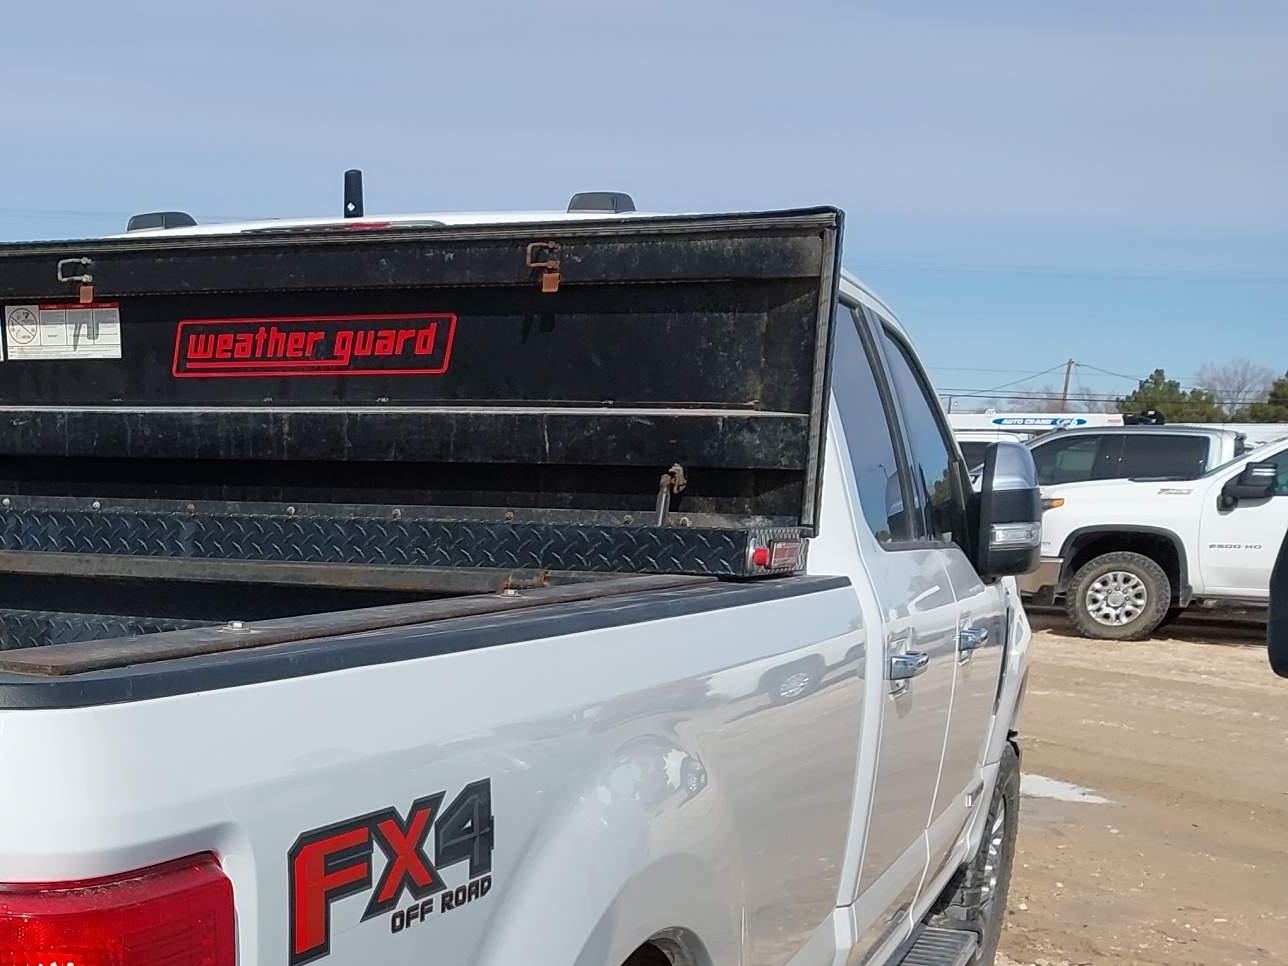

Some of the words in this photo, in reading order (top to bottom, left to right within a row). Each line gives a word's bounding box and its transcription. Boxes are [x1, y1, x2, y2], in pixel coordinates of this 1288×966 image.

[187, 325, 326, 360] weather
[335, 322, 438, 366] guard
[390, 898, 434, 934] OFF
[440, 875, 492, 914] ROAD
